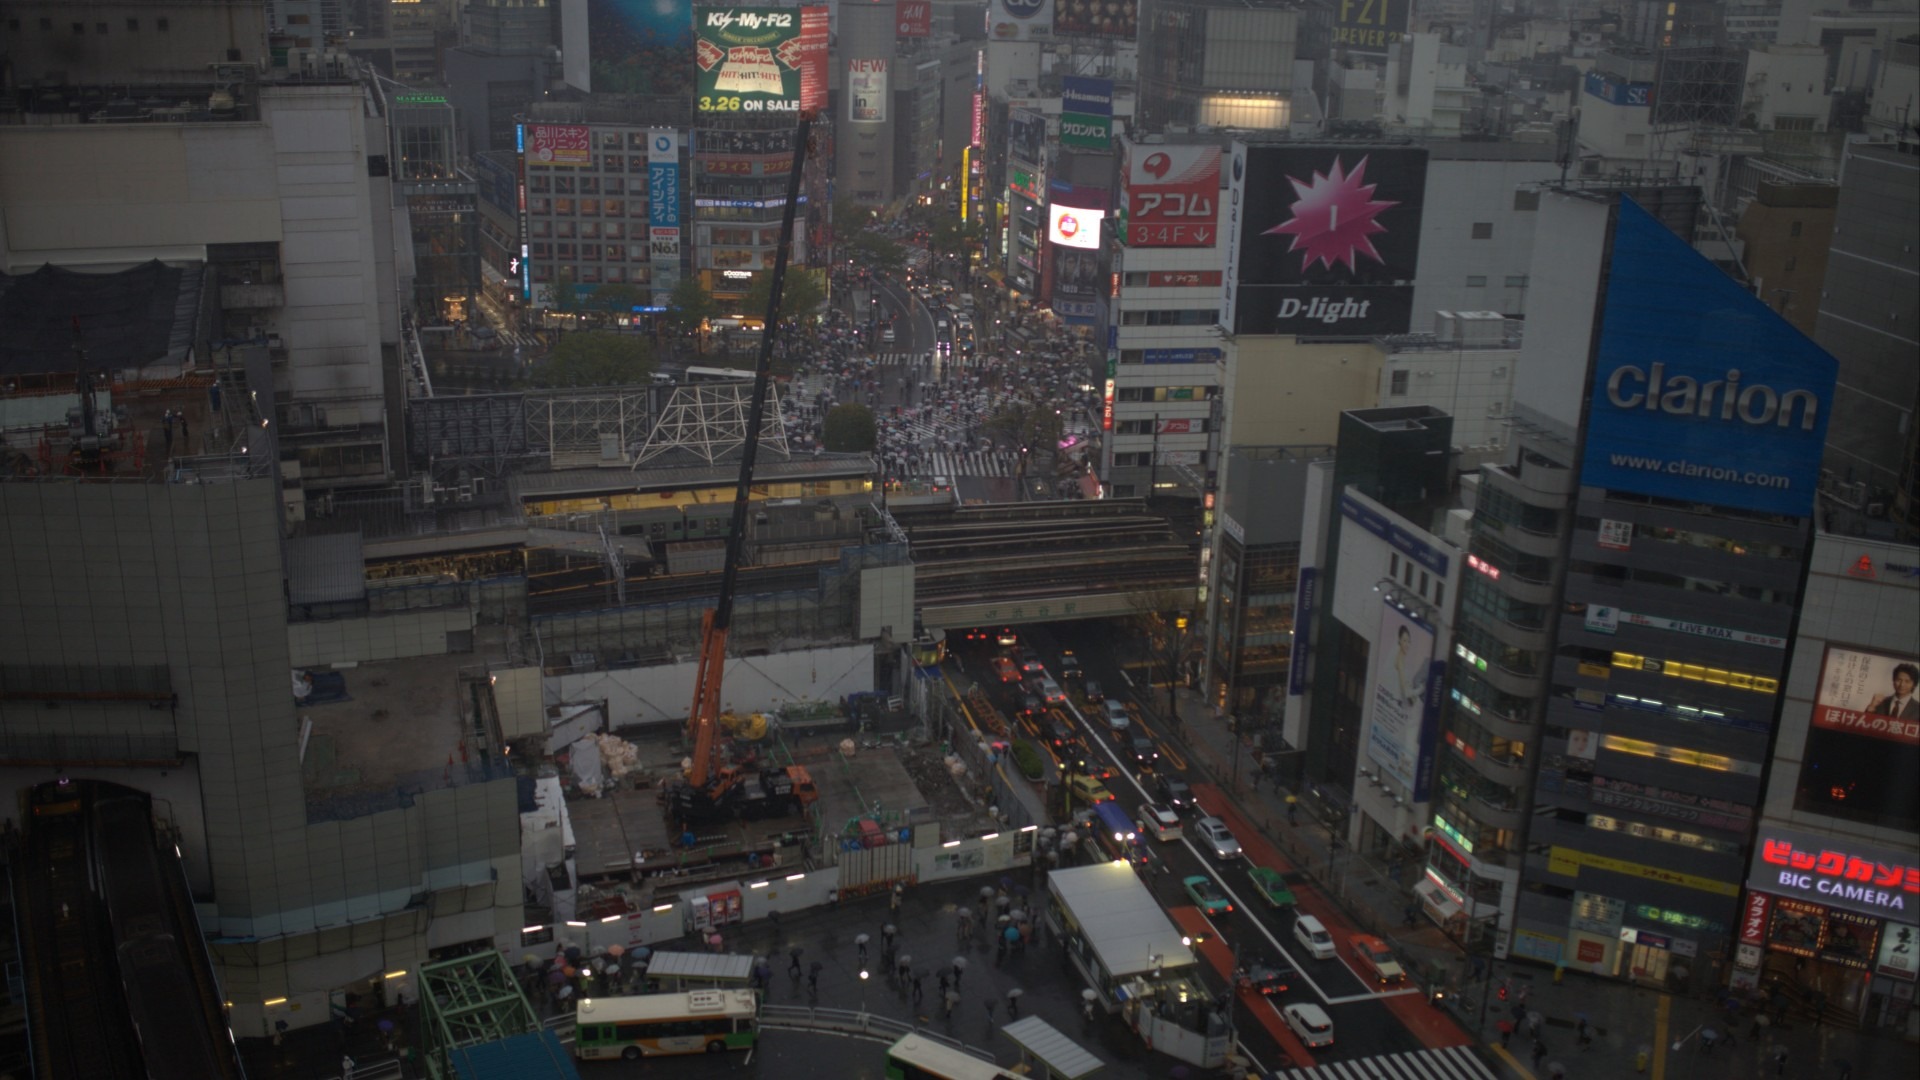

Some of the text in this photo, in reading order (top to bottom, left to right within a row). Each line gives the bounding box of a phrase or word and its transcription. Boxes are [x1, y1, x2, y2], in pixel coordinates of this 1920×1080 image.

[848, 58, 888, 72] NEW!
[698, 96, 800, 112] 3.26 ON SALE
[536, 126, 587, 138] 品川スキン
[536, 139, 588, 150] クリニック
[763, 159, 793, 172] コンタク
[651, 167, 665, 223] アイシティ
[666, 167, 677, 223] コンタクトの
[1136, 192, 1212, 217] アコム
[1610, 452, 1790, 489] www.clarion.com
[1706, 627, 1733, 639] MAX
[1825, 708, 1919, 738] ほけんの窓口
[1777, 869, 1905, 910] BIC CAMERA
[1745, 895, 1766, 937] カラオケ
